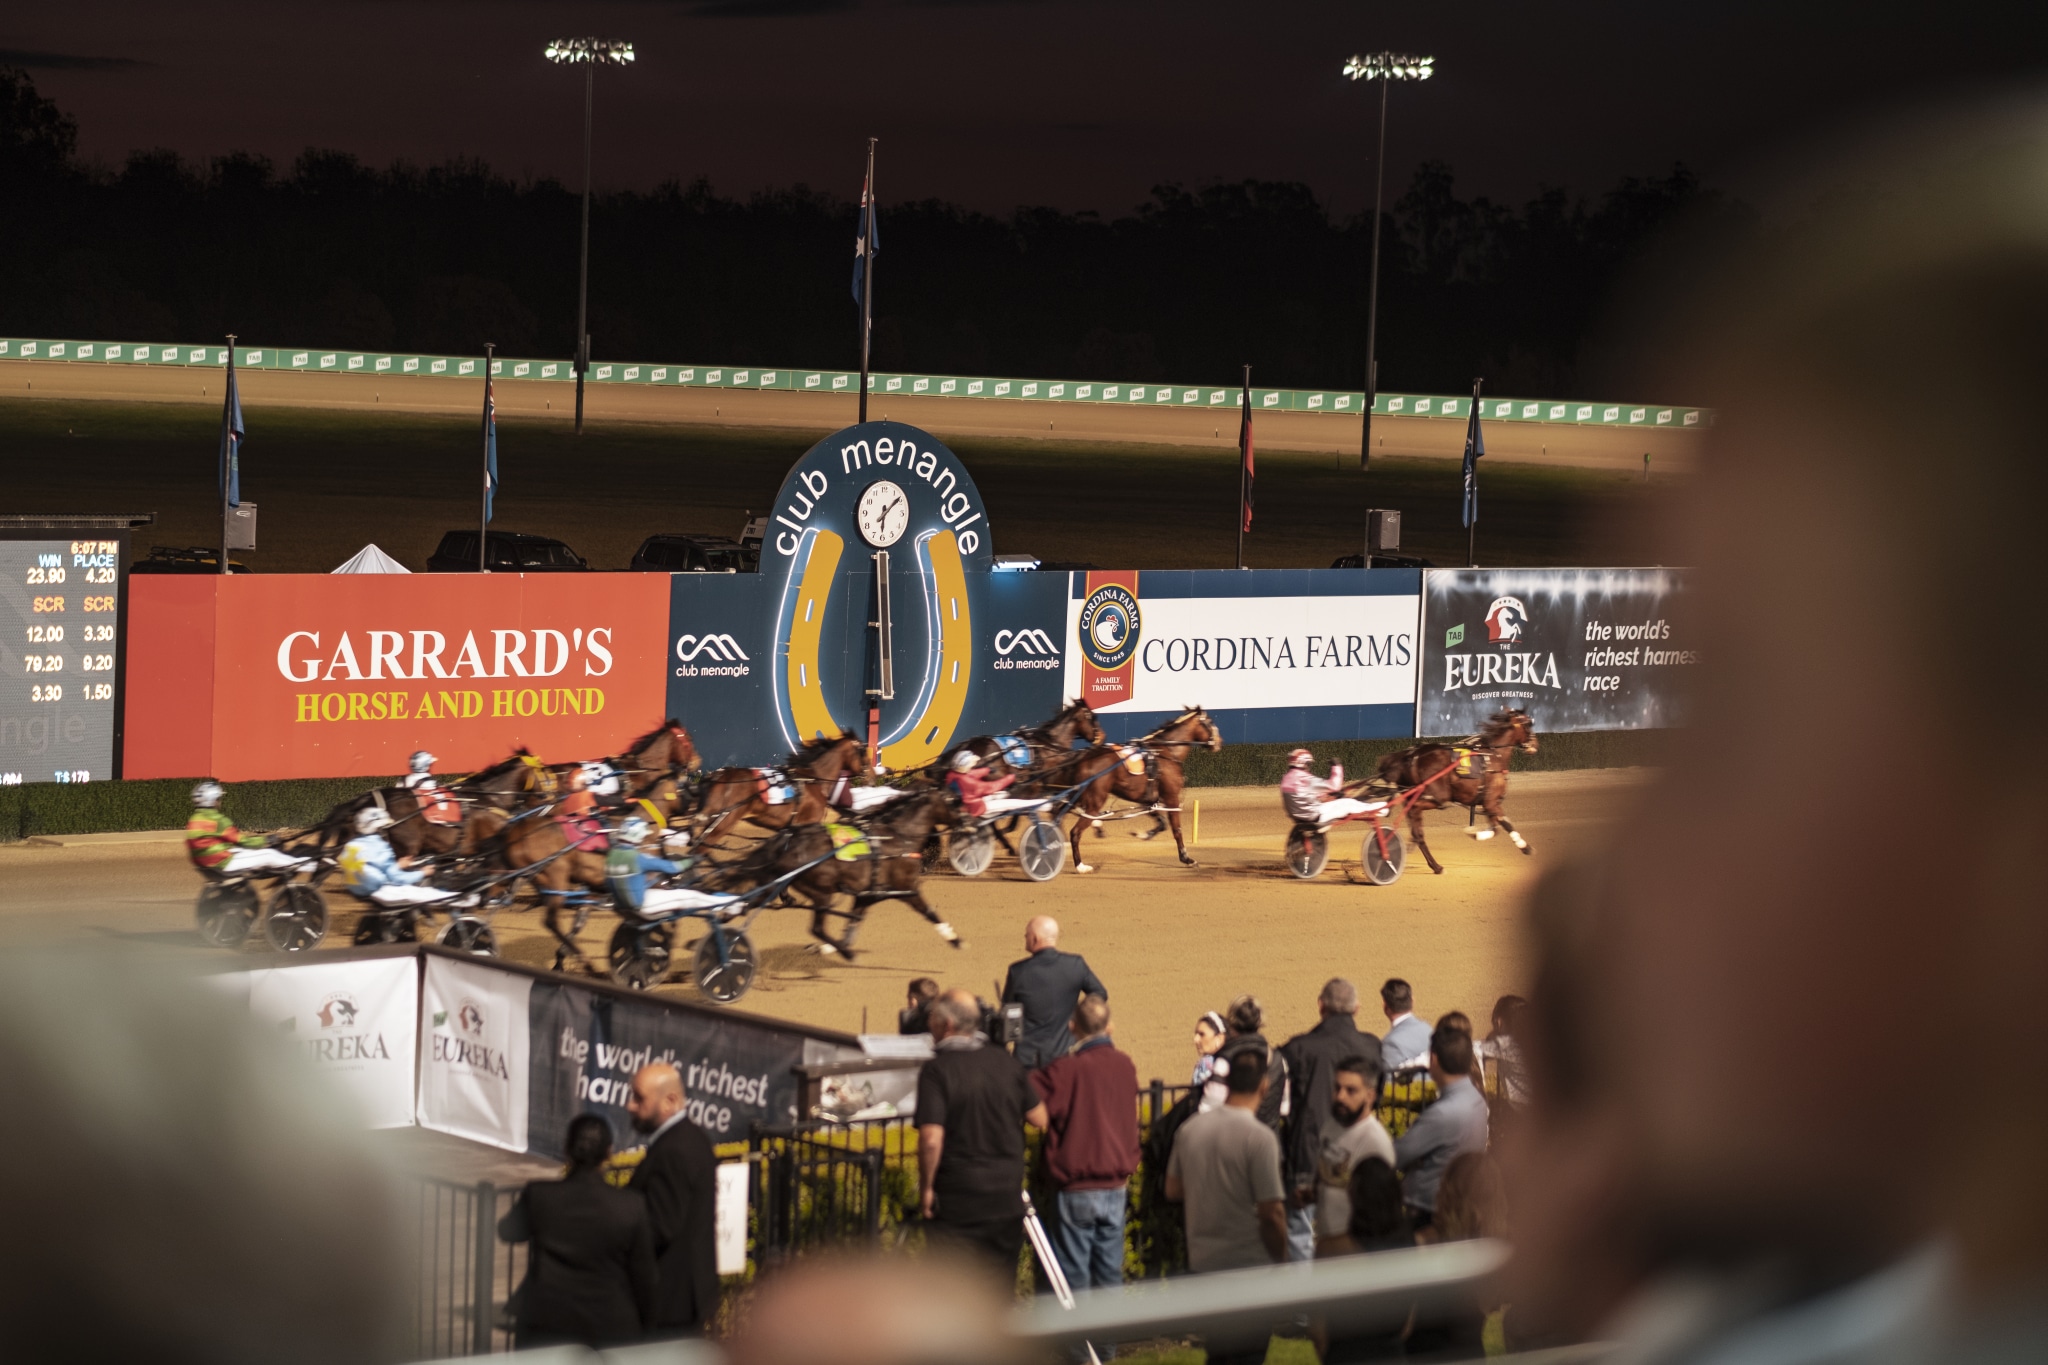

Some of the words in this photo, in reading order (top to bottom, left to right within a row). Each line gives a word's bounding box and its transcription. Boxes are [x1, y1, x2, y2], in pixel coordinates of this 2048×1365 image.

[776, 470, 828, 556] club
[841, 438, 981, 555] menangle
[70, 542, 96, 554] 6:07
[98, 541, 118, 554] PM
[38, 554, 62, 568] WIN
[74, 554, 114, 568] PLACE
[86, 567, 116, 584] 4.20
[33, 596, 65, 613] SCR
[83, 596, 115, 612] SCR
[1082, 589, 1118, 630] CORDINA
[1118, 592, 1138, 630] FARMS
[26, 626, 64, 642] 12.00
[84, 625, 114, 642] 3.30
[1448, 632, 1462, 640] TAB
[1585, 620, 1612, 640] the
[1615, 620, 1670, 640] world's
[277, 628, 613, 682] GARRARD'S
[1094, 652, 1110, 662] SINCE
[1142, 636, 1296, 672] CORDINA
[1304, 634, 1411, 668] FARMS
[1584, 646, 1640, 666] richest
[1643, 646, 1703, 666] harnes
[24, 655, 64, 672] 79.20
[83, 655, 113, 672] 9.20
[676, 664, 698, 676] club
[701, 663, 750, 678] menangle
[994, 657, 1014, 670] club
[1016, 656, 1060, 670] menangle
[1444, 652, 1562, 692] EUREKA
[1583, 676, 1620, 691] race
[32, 684, 62, 702] 3.30
[83, 684, 112, 700] 1.50
[1472, 691, 1500, 700] DISCOVER
[1502, 690, 1534, 698] GREATNESS
[296, 691, 409, 722] HORSE
[414, 690, 484, 718] AND
[490, 688, 605, 717] HOUND
[432, 1033, 509, 1080] EUREKA
[561, 1026, 589, 1064] the
[687, 1058, 768, 1108] richest
